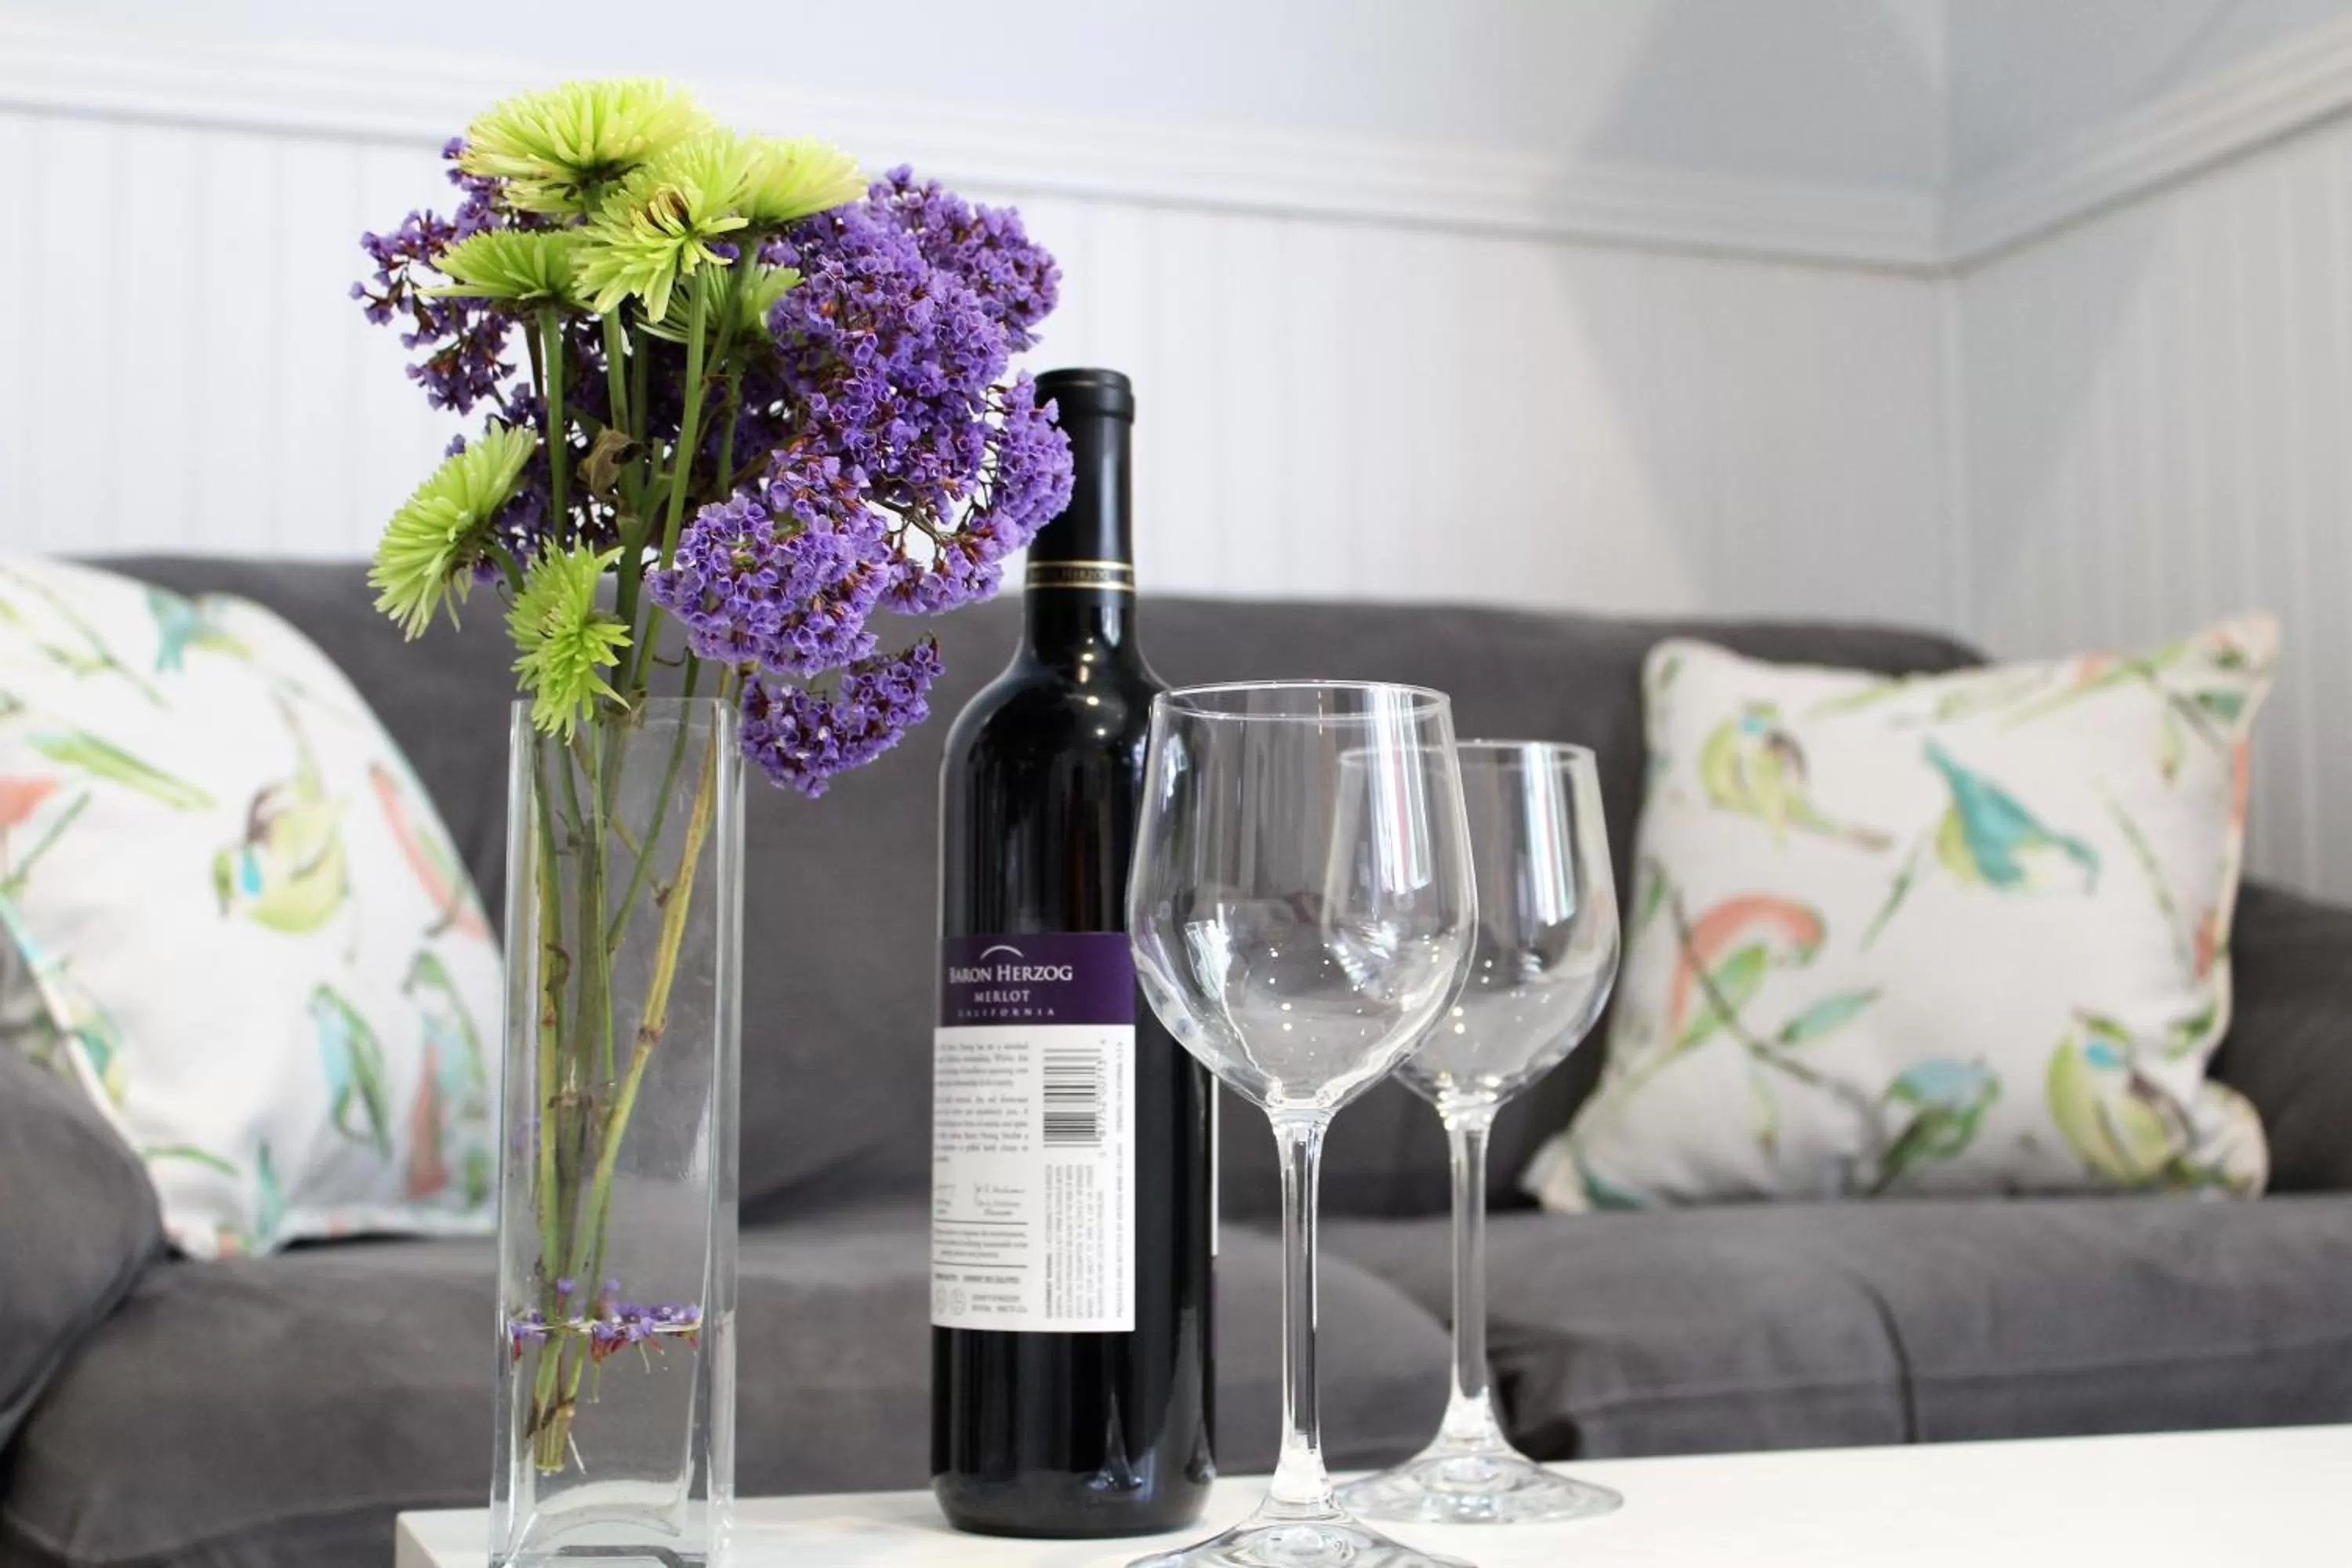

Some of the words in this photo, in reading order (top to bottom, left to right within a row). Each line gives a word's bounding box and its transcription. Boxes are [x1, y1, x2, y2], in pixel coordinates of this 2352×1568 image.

[996, 964, 1073, 982] HERZOG
[974, 989, 1030, 1003] MERLOT
[957, 1007, 1054, 1018] CALIFORNIA
